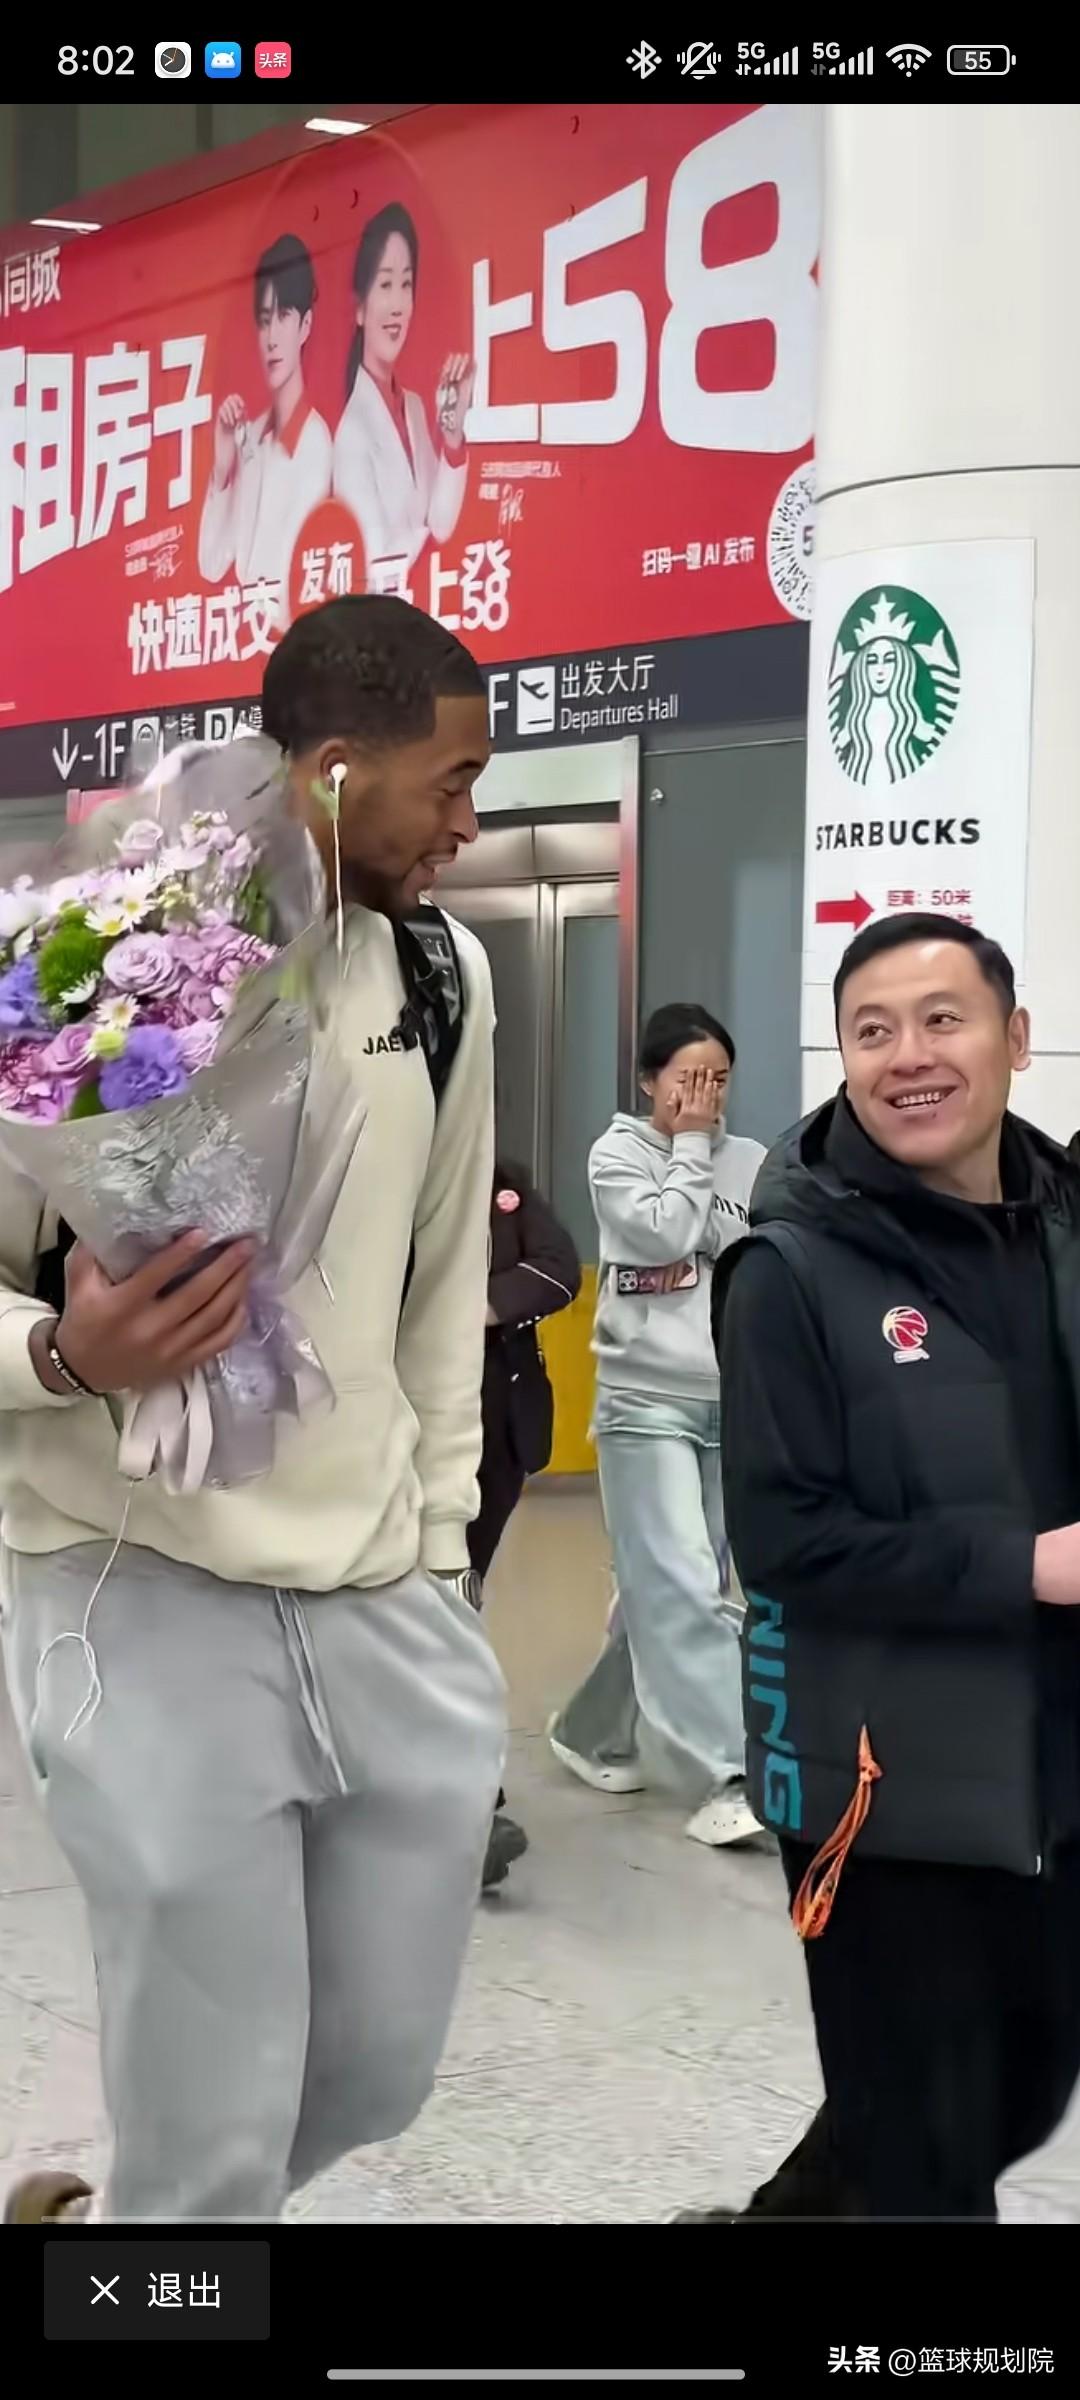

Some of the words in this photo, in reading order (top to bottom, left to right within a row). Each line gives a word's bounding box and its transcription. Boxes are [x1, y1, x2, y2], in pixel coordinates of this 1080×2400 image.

[0, 245, 61, 318] 同城
[300, 541, 354, 604] 发布
[704, 544, 720, 566] AI
[128, 577, 280, 676] 快速成交
[560, 654, 656, 699] 出发大厅
[560, 702, 644, 735] Departures
[648, 693, 679, 721] Hall
[815, 818, 981, 850] STARBUCKS
